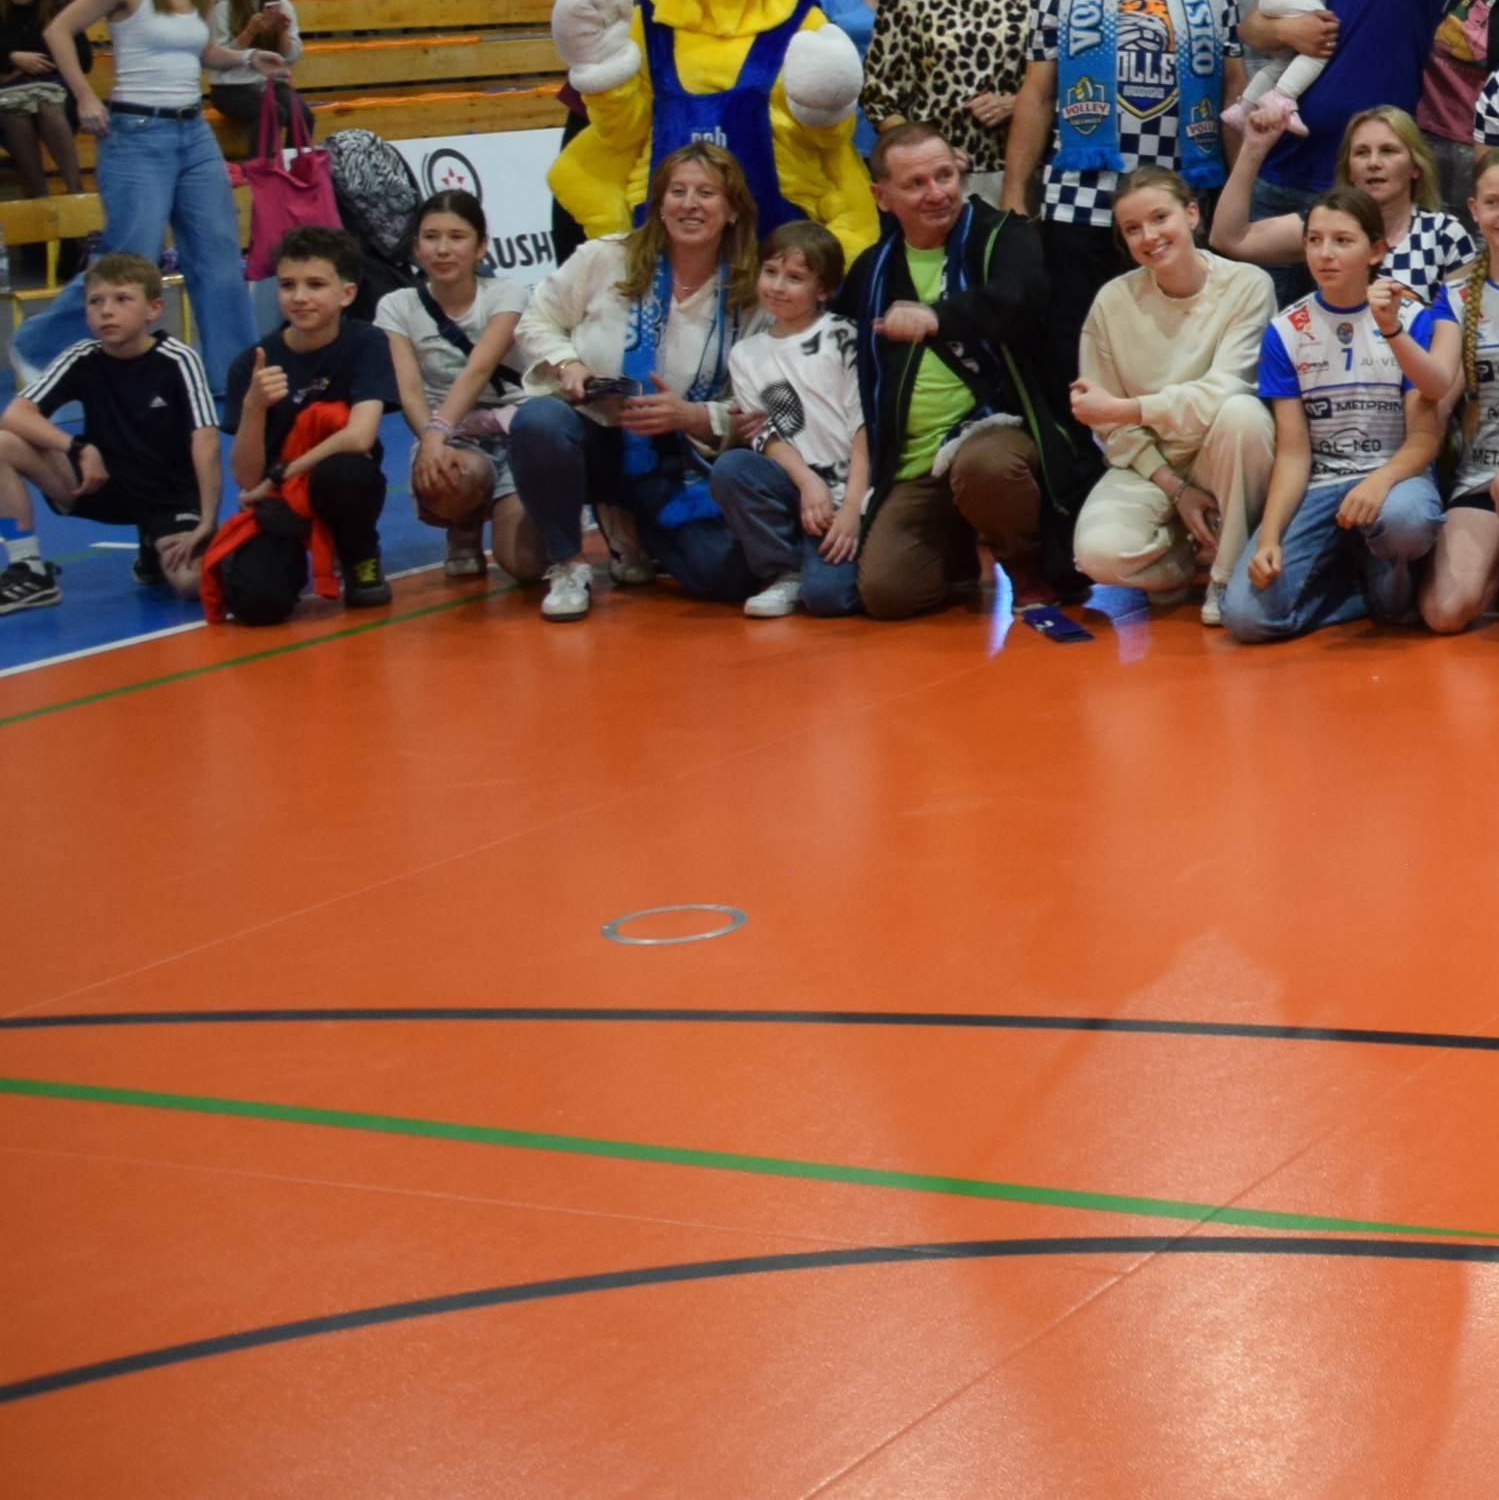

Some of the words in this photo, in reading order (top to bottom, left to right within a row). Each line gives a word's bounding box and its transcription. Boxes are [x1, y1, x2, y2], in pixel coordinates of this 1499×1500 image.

[1117, 50, 1176, 84] OLLE
[1065, 102, 1108, 115] VOLLEY
[1341, 347, 1353, 372] 7
[1360, 357, 1373, 366] JU
